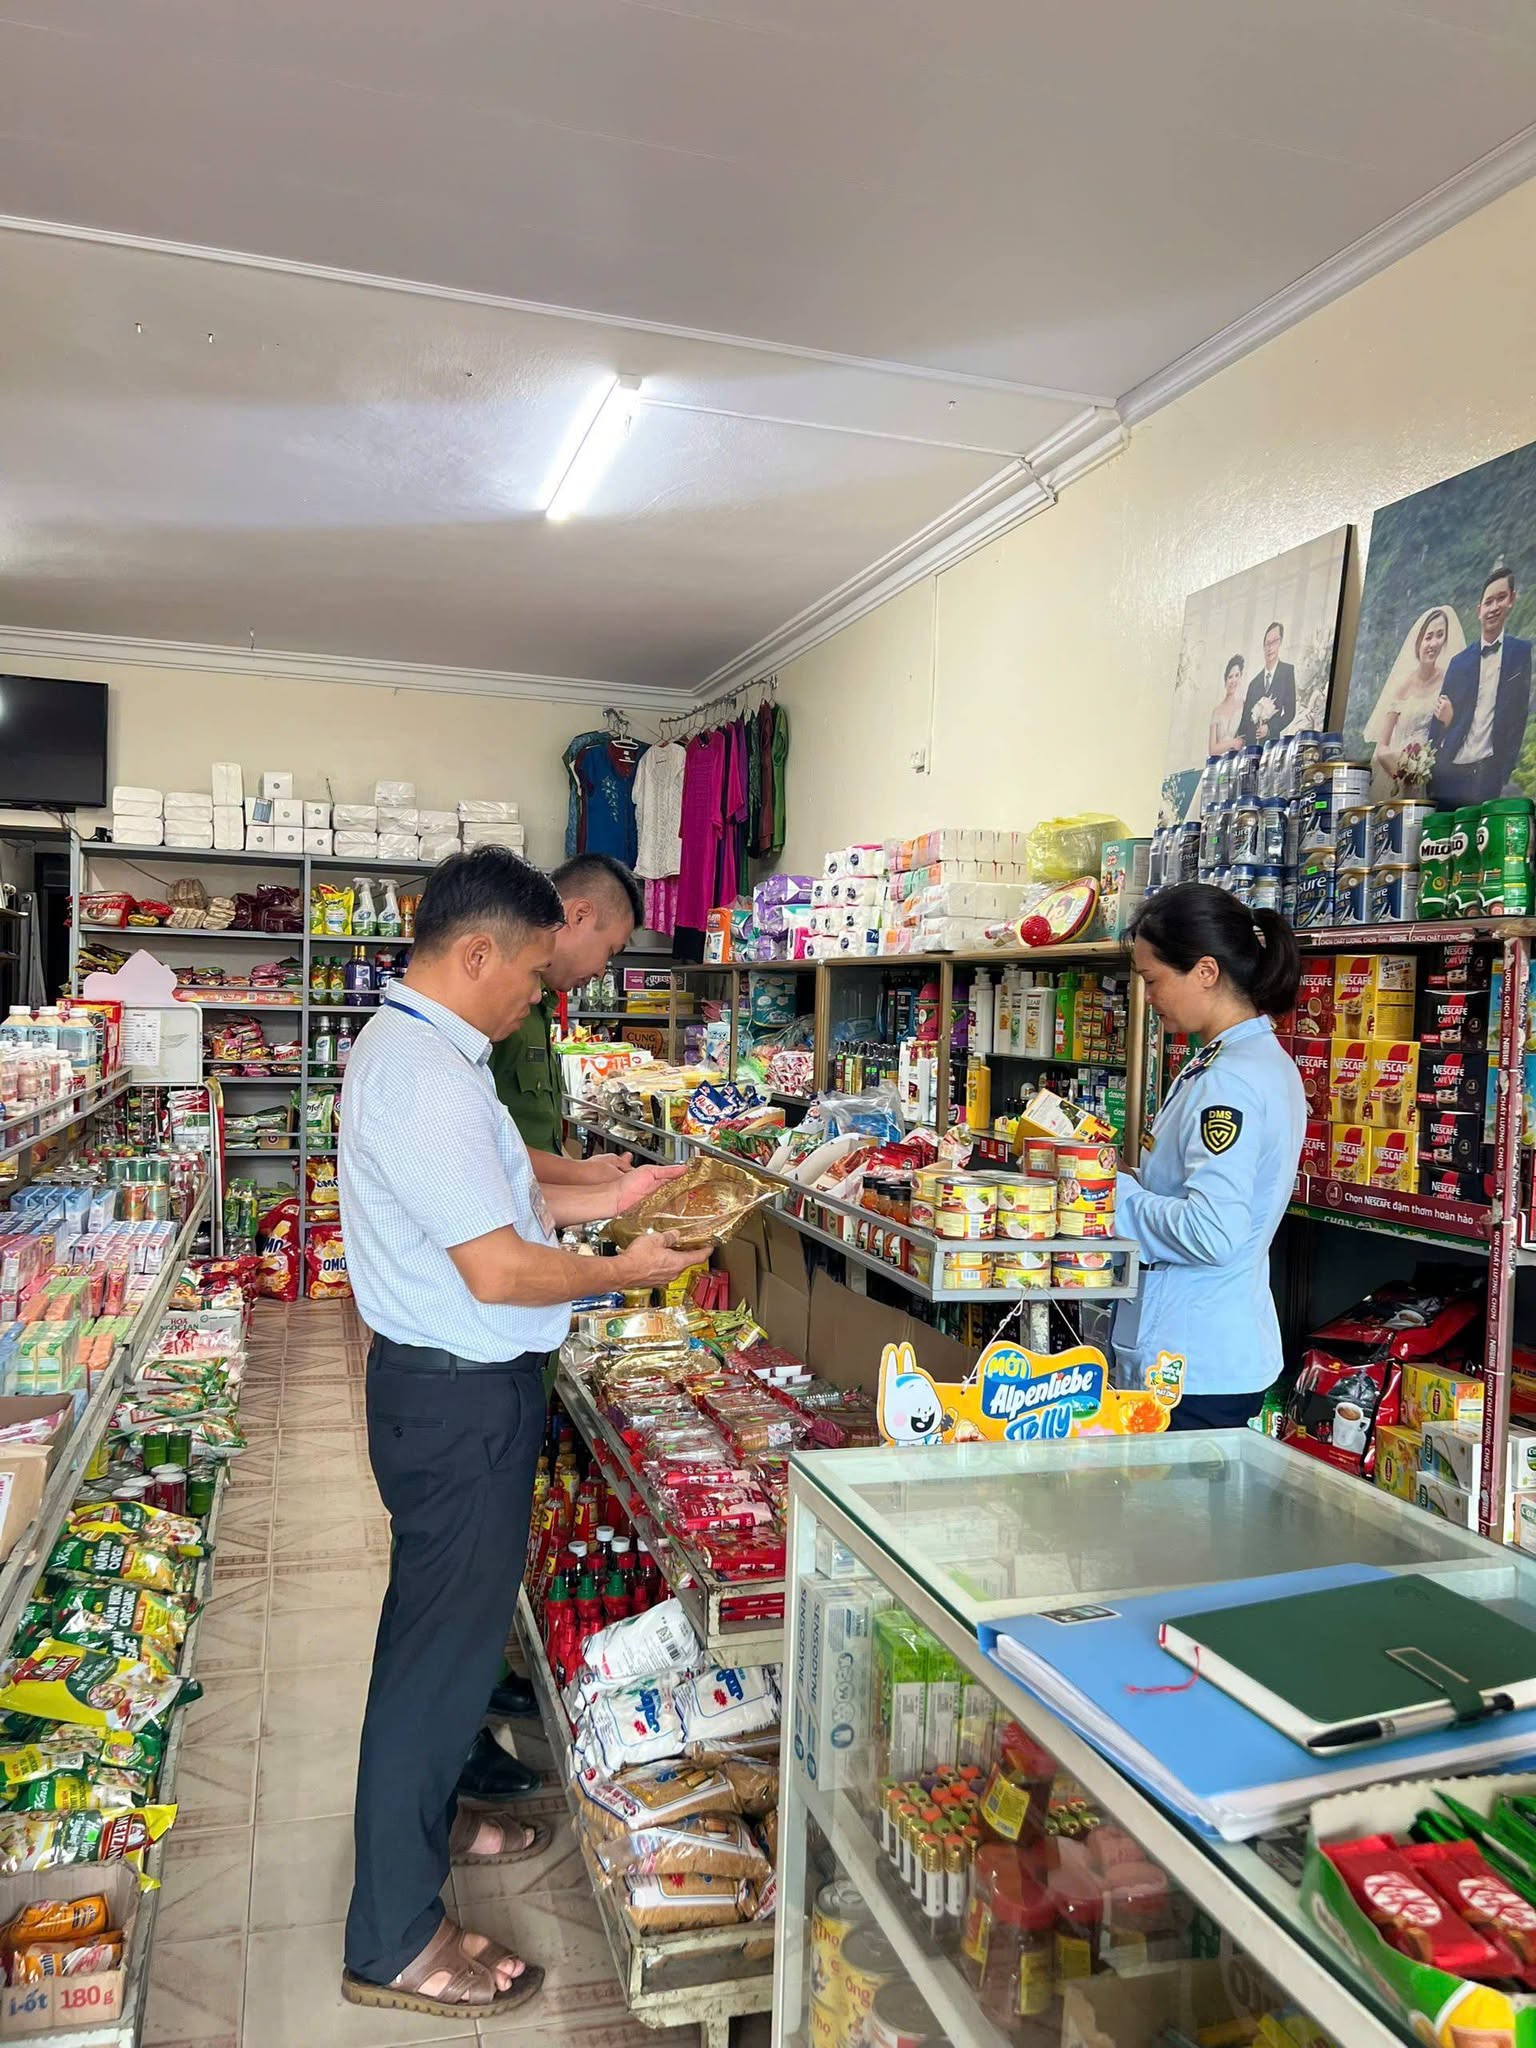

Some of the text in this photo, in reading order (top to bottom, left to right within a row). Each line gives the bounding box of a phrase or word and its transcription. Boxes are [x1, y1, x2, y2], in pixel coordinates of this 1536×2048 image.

[1421, 844, 1451, 857] MILO
[1452, 839, 1464, 851] LO
[1297, 876, 1327, 893] sure
[627, 1031, 656, 1043] CUNG
[1208, 1110, 1233, 1121] DMS
[1345, 1191, 1363, 1205] Chọn
[1392, 1200, 1410, 1214] đậm
[1411, 1204, 1433, 1217] thơm
[1434, 1208, 1455, 1221] hoàn
[263, 1237, 284, 1254] MO
[323, 1257, 347, 1271] OMO
[988, 1351, 1027, 1380] MỚI
[990, 1366, 1095, 1422] Alpenliebe
[797, 1587, 808, 1690] SENSODYNE
[808, 1602, 821, 1706] SENSODYNE
[107, 1814, 131, 1860] MEIZAN
[60, 1985, 101, 2010] 180
[103, 1989, 114, 2006] g
